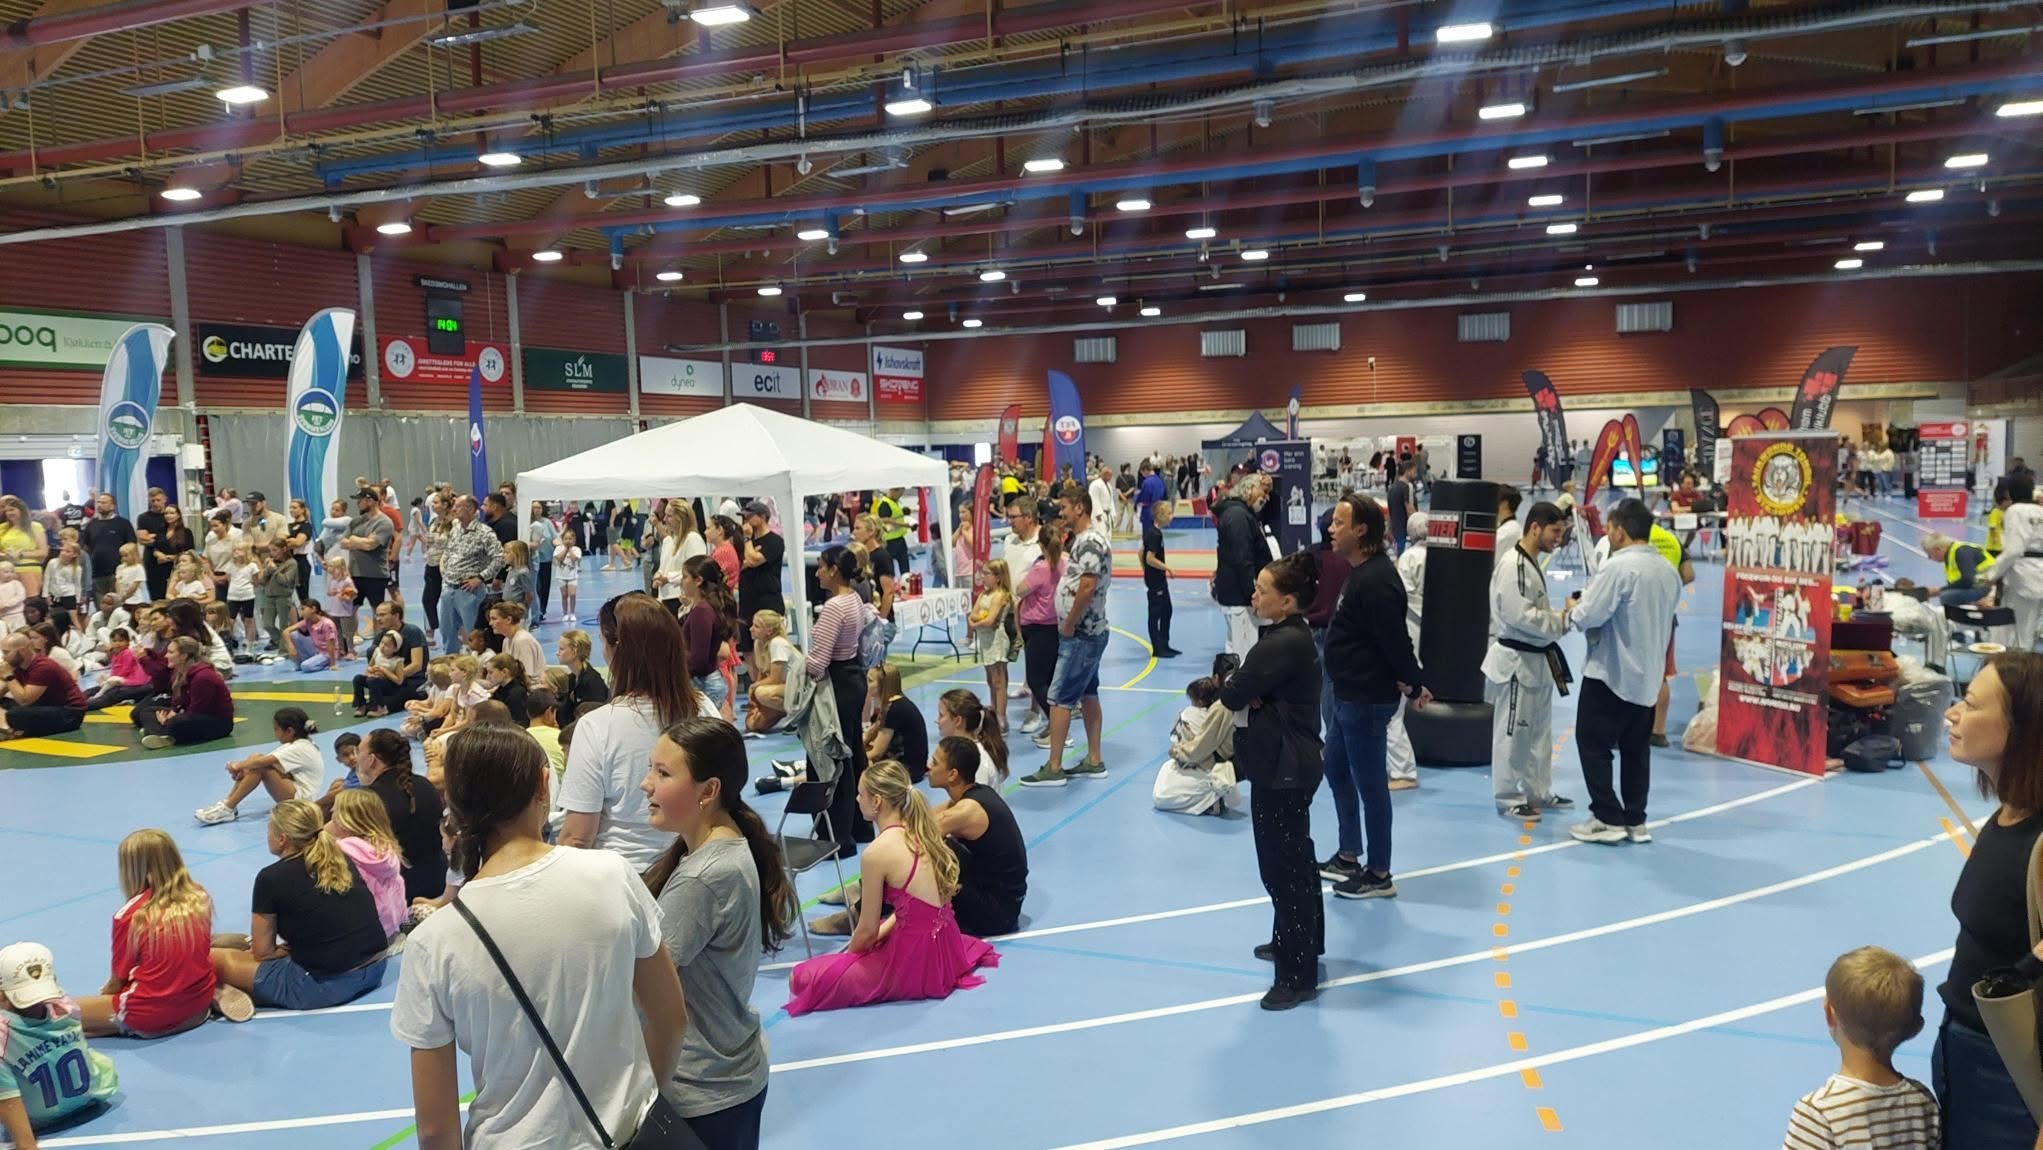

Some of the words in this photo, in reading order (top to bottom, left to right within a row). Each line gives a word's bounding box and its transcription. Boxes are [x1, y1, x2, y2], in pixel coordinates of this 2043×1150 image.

[564, 361, 593, 379] SLM
[670, 374, 696, 391] dynea
[754, 371, 781, 394] ecit
[27, 1047, 91, 1109] 10
